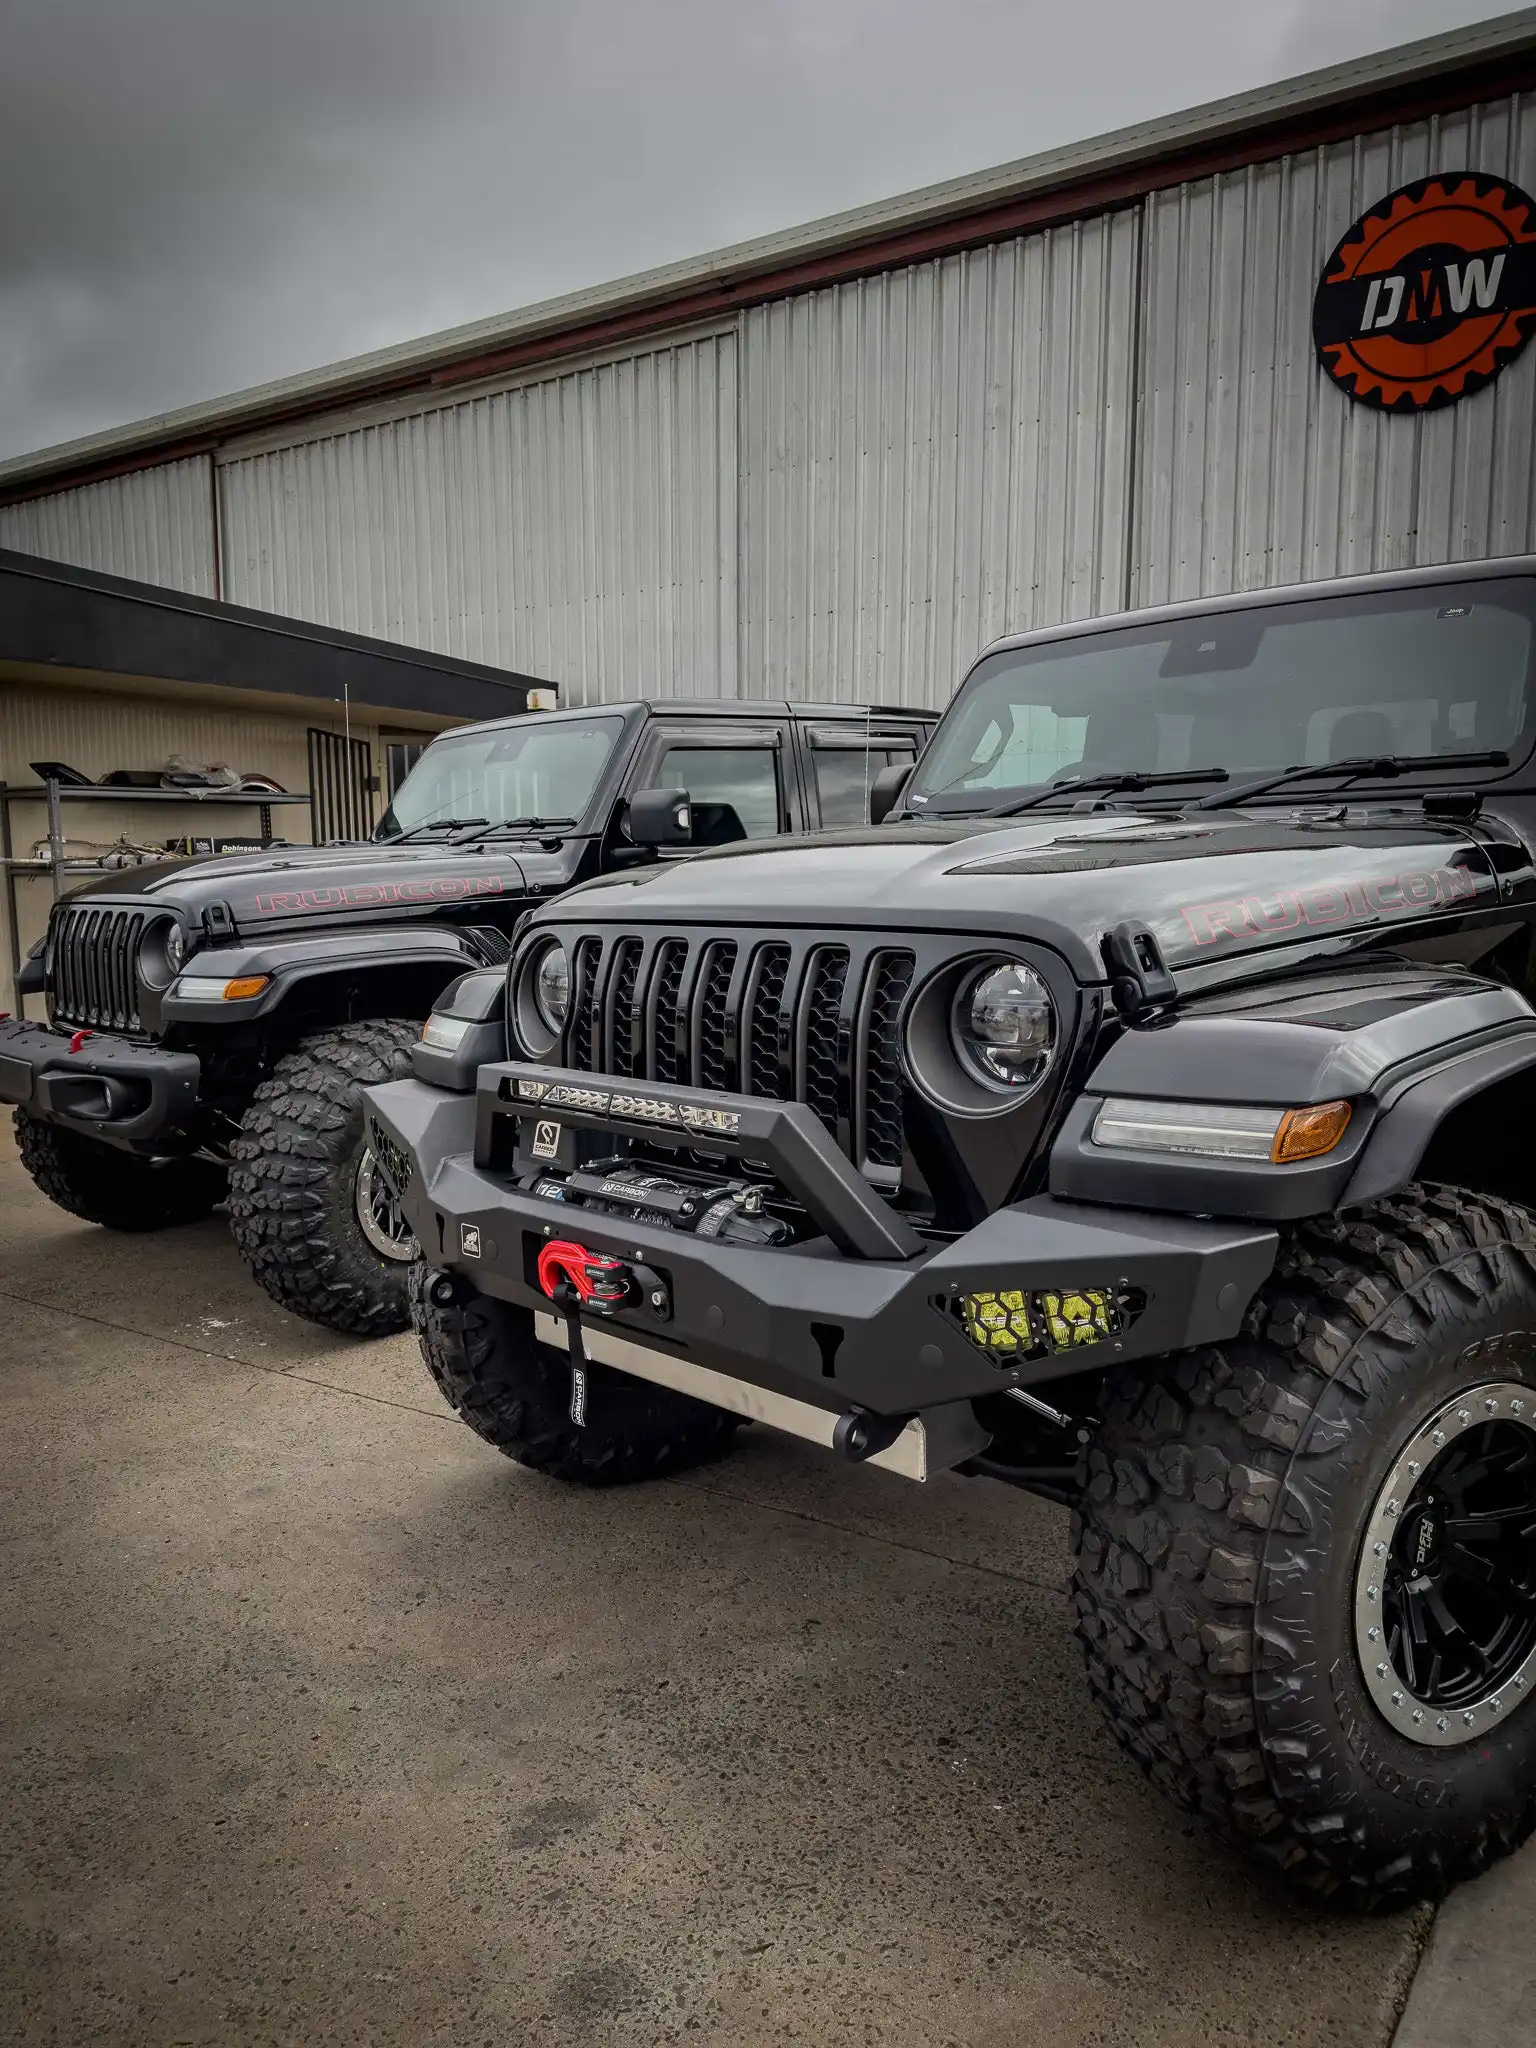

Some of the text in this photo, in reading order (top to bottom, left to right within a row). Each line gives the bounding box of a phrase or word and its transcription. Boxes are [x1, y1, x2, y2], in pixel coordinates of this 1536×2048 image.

[1359, 253, 1507, 331] DMW
[221, 844, 262, 852] Dobinsons
[255, 875, 504, 912] RUBICON
[1180, 864, 1478, 946] RUBICON
[613, 1183, 647, 1197] CARBON
